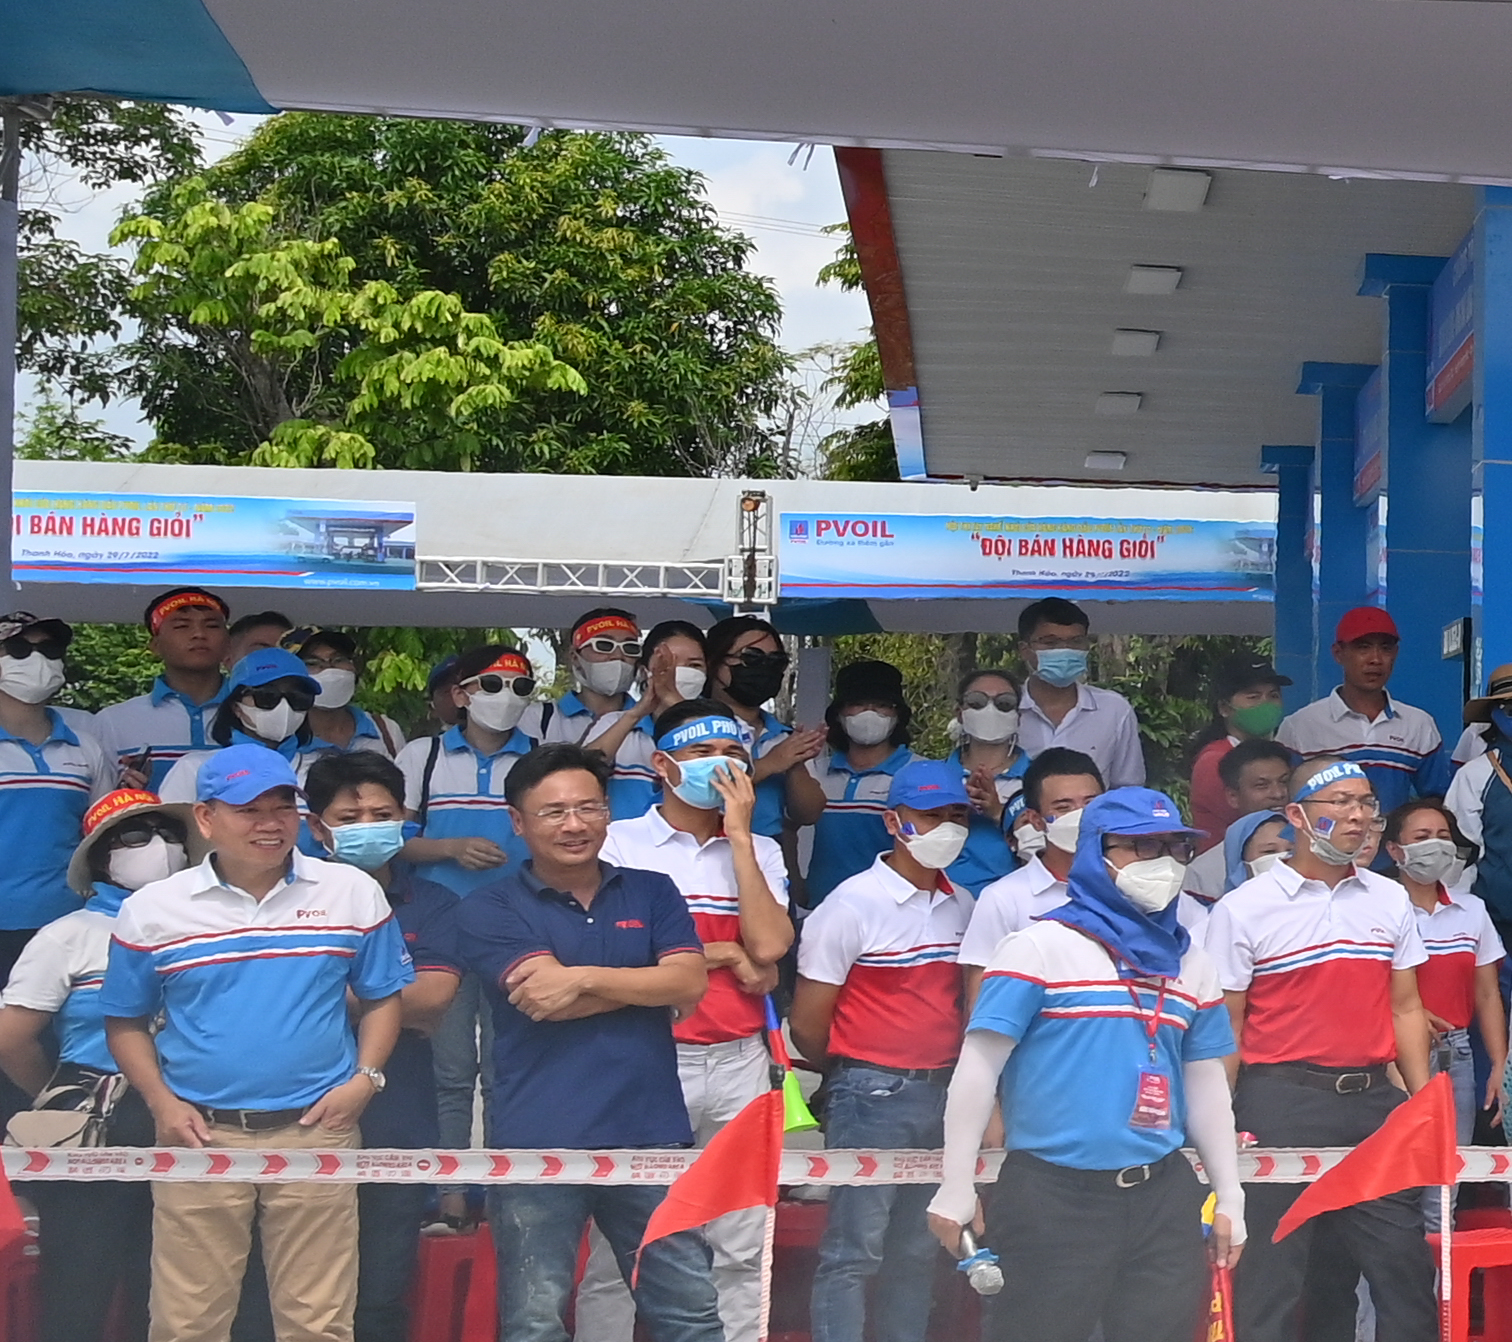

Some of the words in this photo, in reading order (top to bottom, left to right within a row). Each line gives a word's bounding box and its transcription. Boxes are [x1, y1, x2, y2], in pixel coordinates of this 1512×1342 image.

[30, 510, 75, 537] BÁN
[81, 512, 142, 537] HÀNG
[815, 519, 895, 539] PVOIL
[1018, 533, 1057, 558] BÁN
[1062, 534, 1114, 560] HÀNG
[673, 723, 710, 746] PVOIL
[1307, 765, 1344, 790] PVOIL
[87, 803, 112, 825] PVOIL
[114, 792, 133, 808] HÀ
